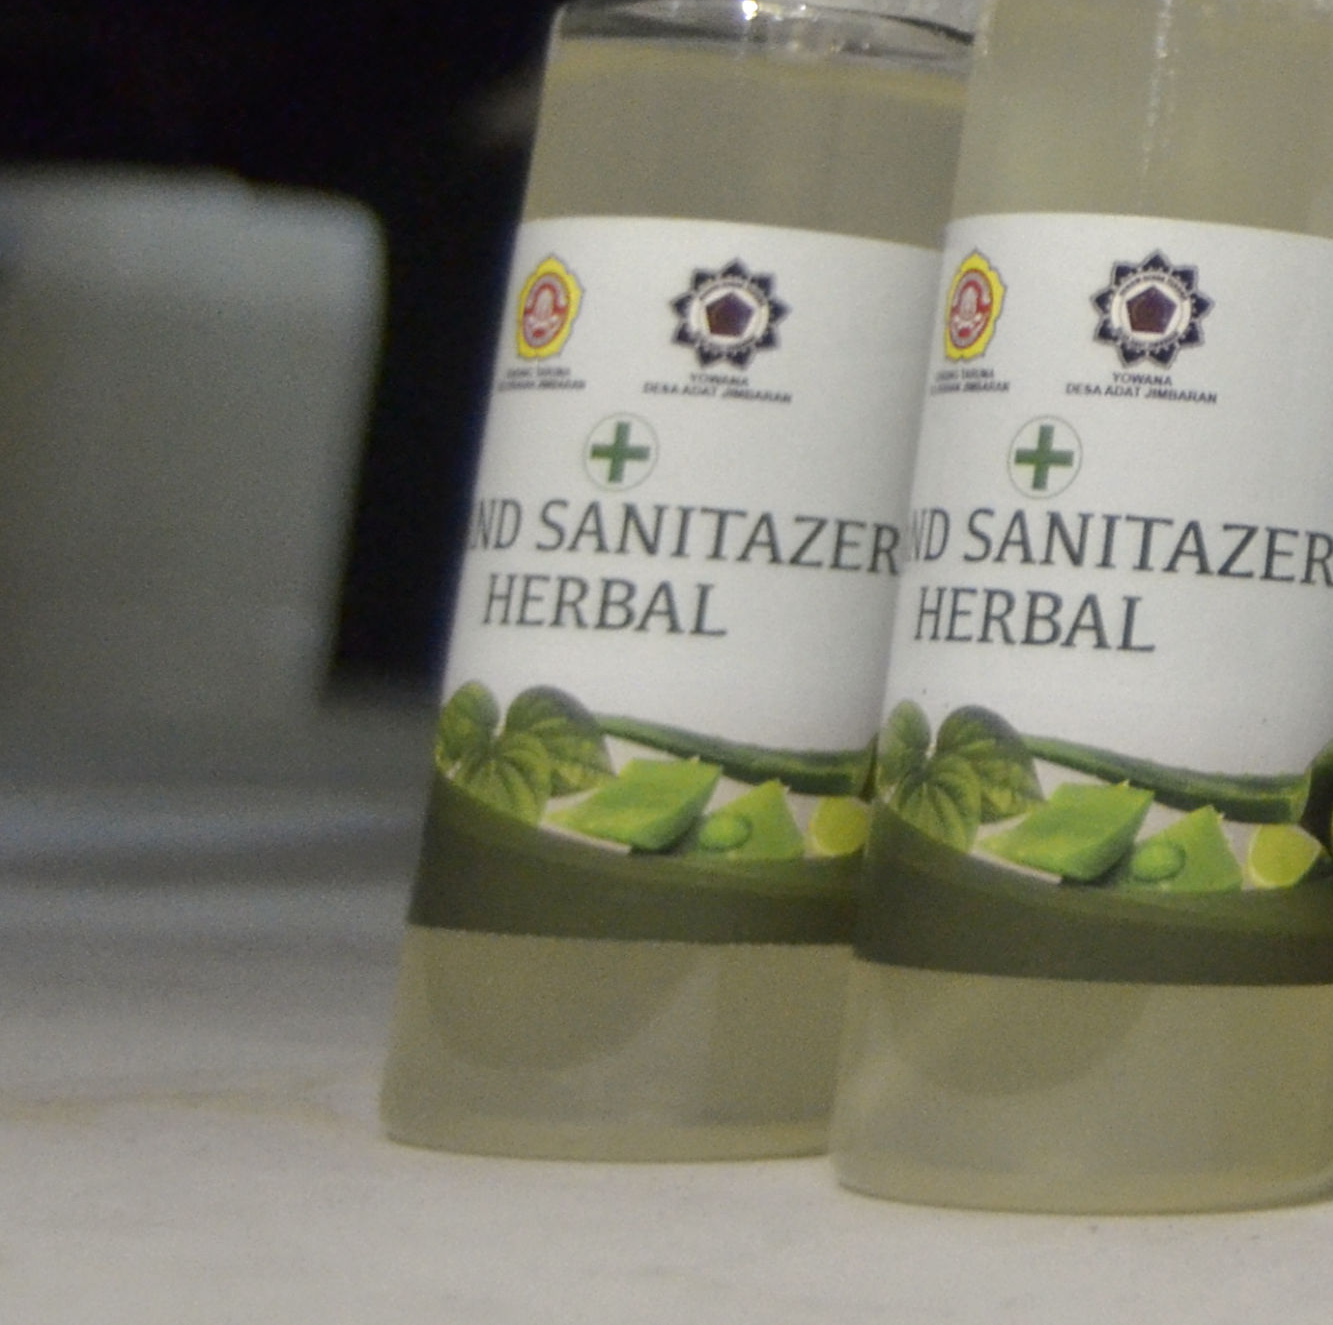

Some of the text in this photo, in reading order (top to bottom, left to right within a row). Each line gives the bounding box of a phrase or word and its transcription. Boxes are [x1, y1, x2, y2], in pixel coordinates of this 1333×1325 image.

[643, 381, 679, 395] DESA
[682, 383, 718, 397] ADAT
[690, 371, 750, 387] YOWANA
[1112, 371, 1173, 386] YOWANA
[1065, 382, 1218, 405] DESA ADAT JIMBARAN
[535, 498, 900, 576] SANITAZER
[482, 572, 727, 637] HERBAL
[913, 585, 1156, 653] HERBAL
